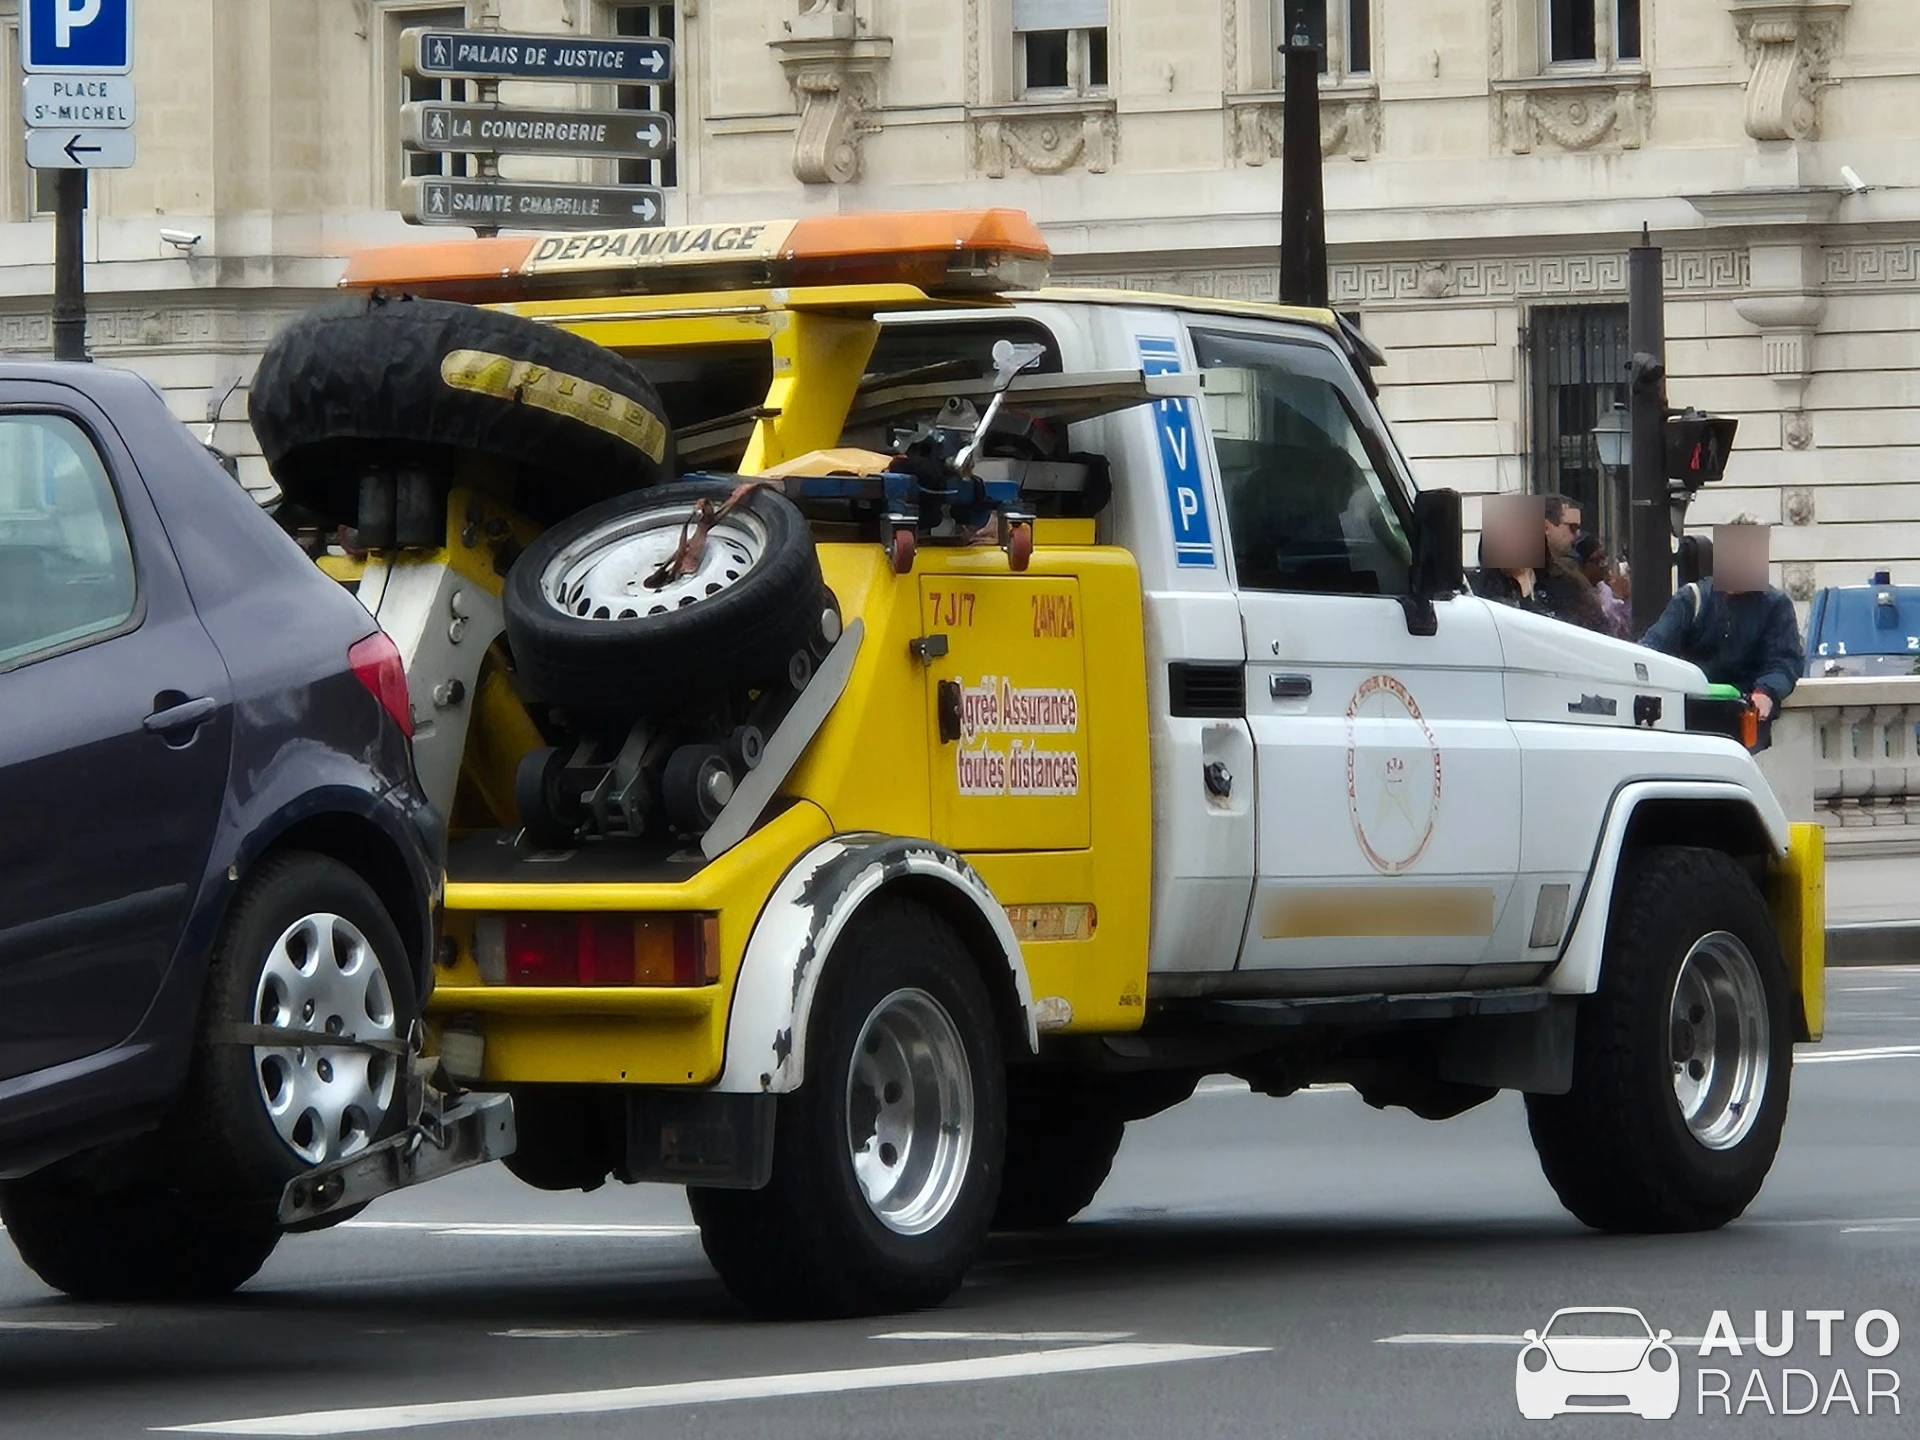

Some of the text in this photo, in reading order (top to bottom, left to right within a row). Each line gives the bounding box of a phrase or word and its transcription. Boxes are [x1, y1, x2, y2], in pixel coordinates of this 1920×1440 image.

[55, 0, 101, 48] P
[458, 44, 625, 69] PALAIS DE JUSTICE
[53, 82, 107, 97] PLACE
[452, 119, 606, 142] LA CONCIERGERIE
[452, 193, 513, 212] SAINTE
[533, 225, 766, 261] DEPANNAGE
[1002, 683, 1077, 726] Assurance
[958, 748, 1078, 789] toutes distances
